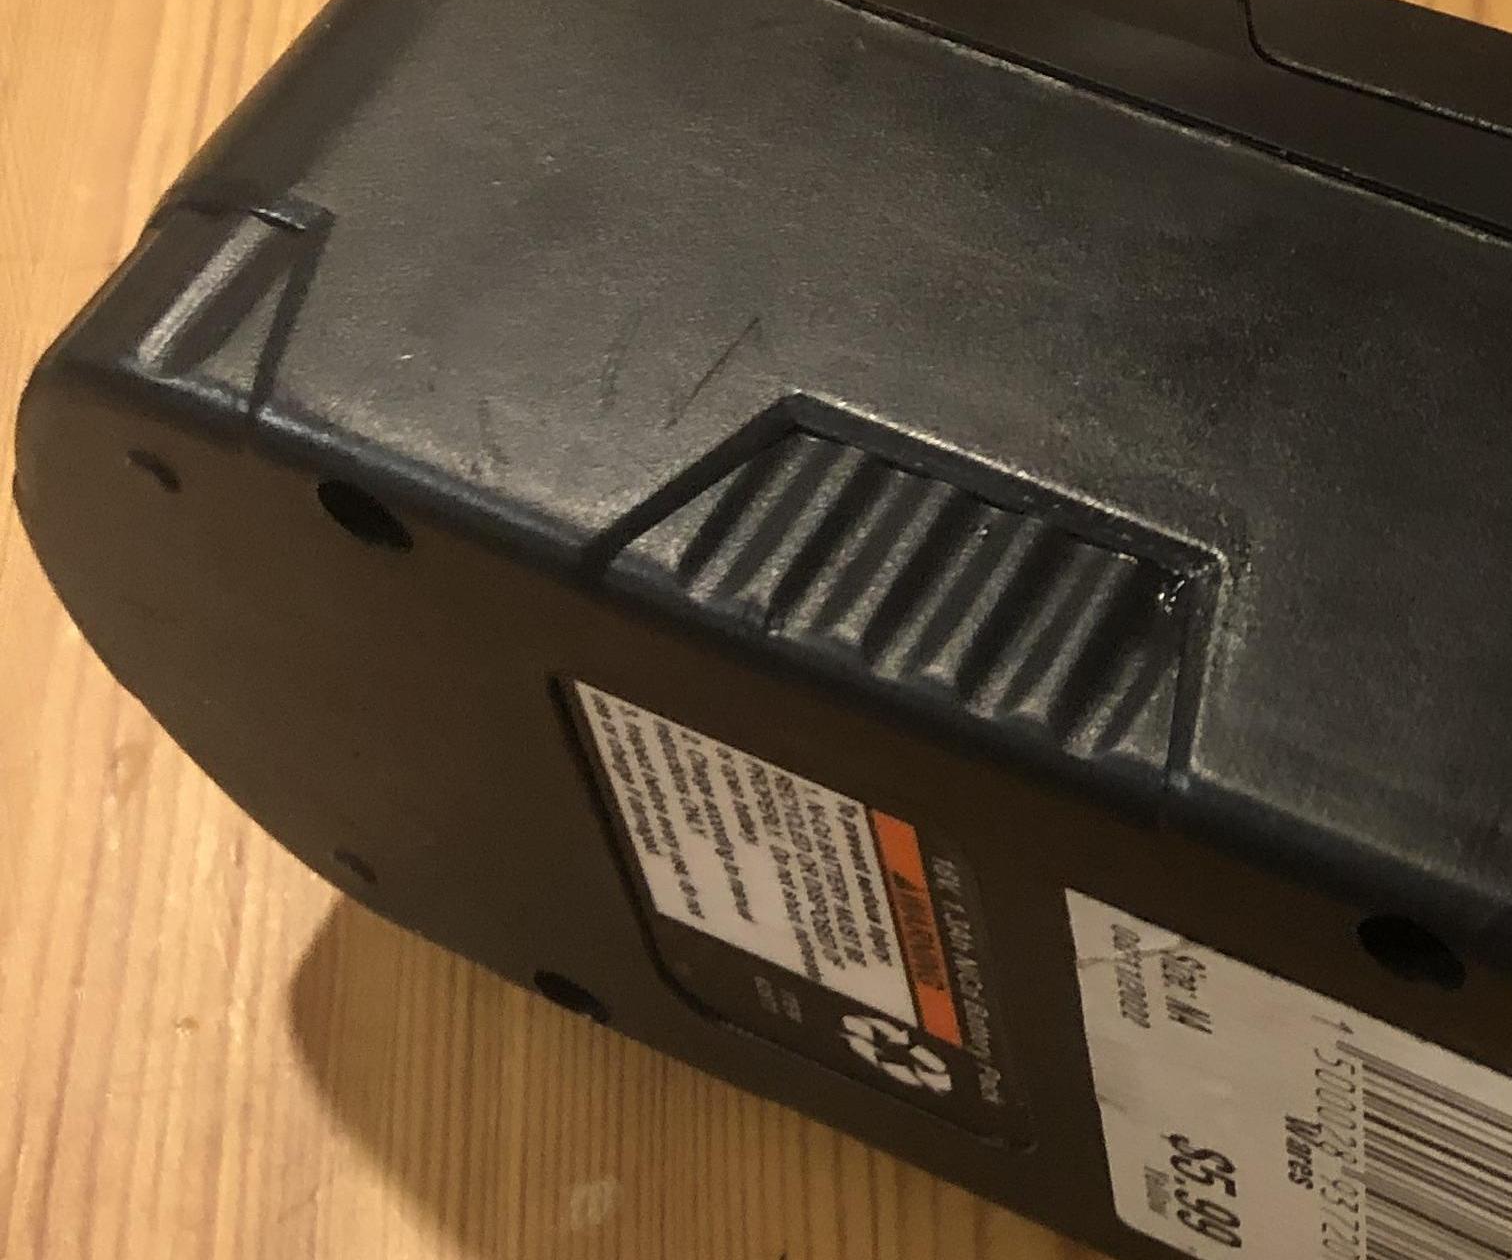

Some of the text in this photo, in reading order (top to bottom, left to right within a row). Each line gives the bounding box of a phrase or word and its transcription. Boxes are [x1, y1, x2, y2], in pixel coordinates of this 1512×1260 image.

[1285, 1115, 1322, 1190] Wares
[1313, 1048, 1357, 1164] 500028
[1160, 1133, 1242, 1248] $5.99
